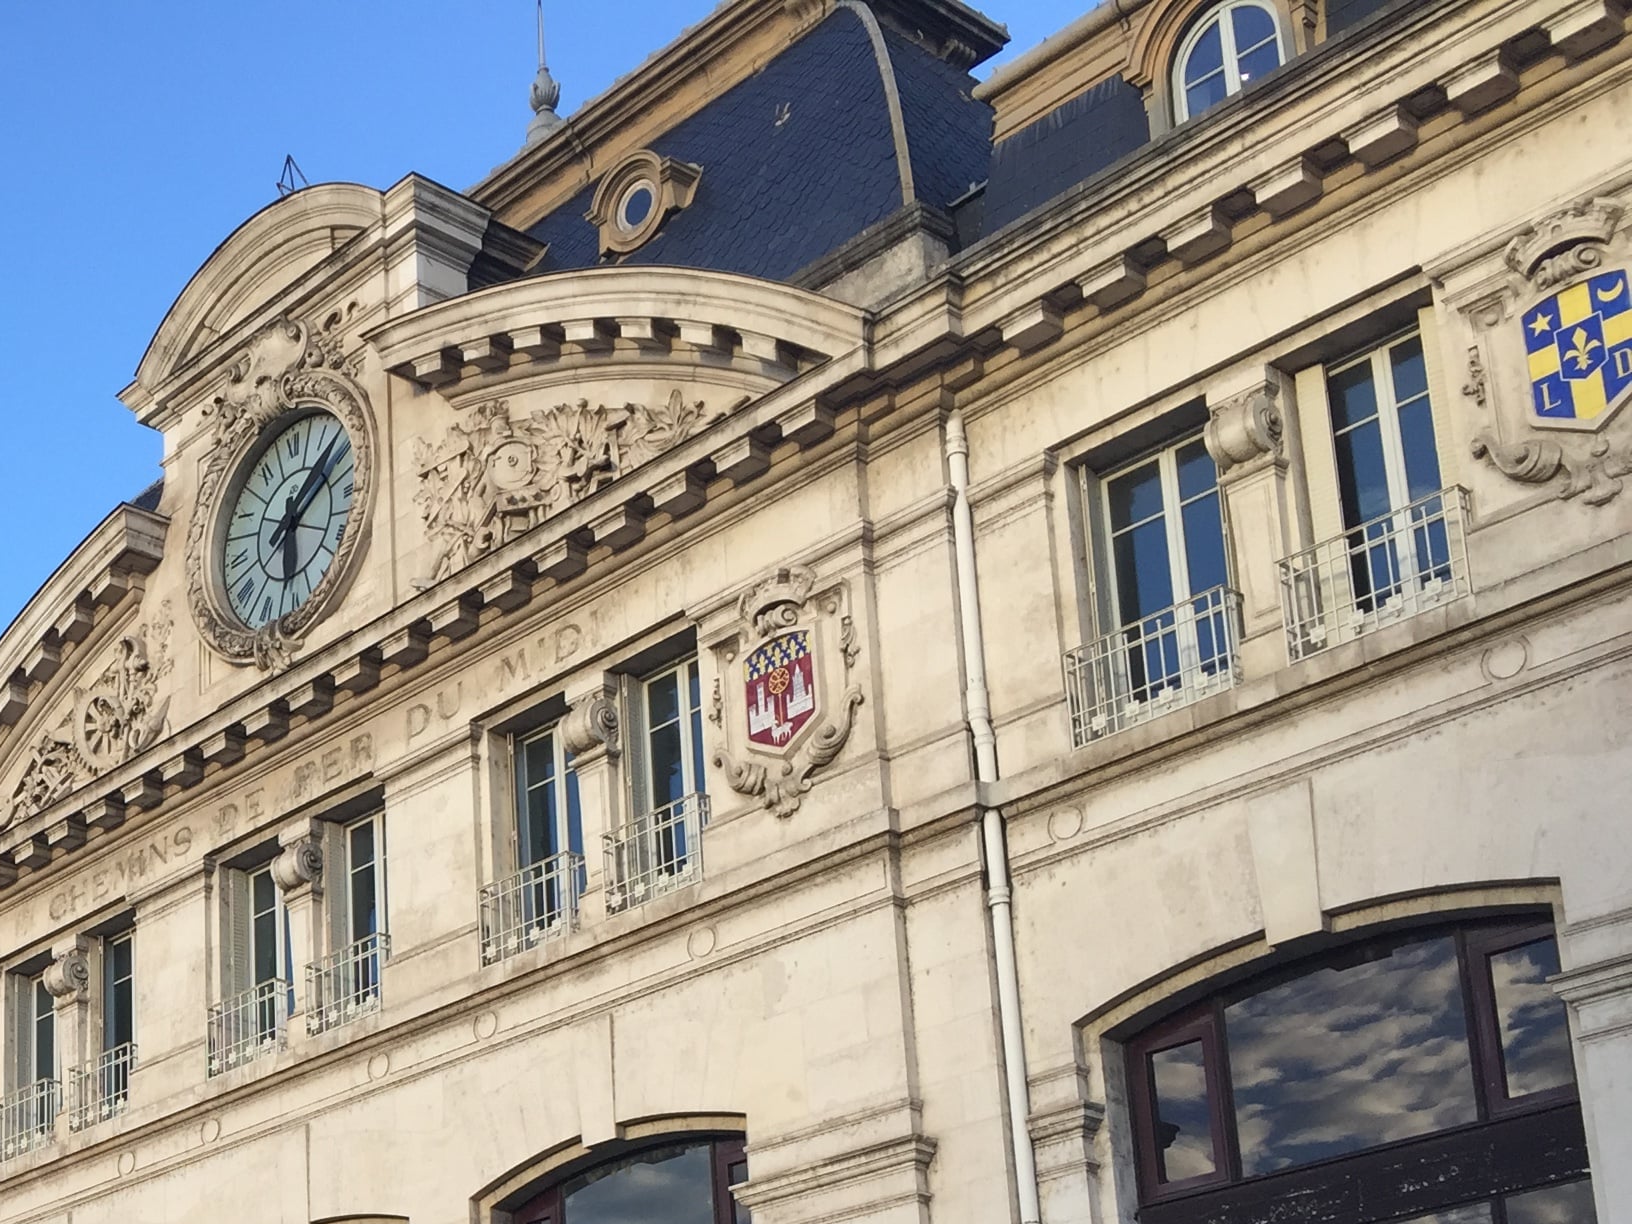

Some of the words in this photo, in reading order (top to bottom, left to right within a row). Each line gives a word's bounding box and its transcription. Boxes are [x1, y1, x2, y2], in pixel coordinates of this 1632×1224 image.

[1540, 383, 1562, 412] L
[286, 431, 300, 459] XII
[260, 462, 274, 487] XI
[237, 508, 255, 522] X
[230, 548, 249, 570] IX
[48, 826, 195, 921] CHEMINS
[218, 786, 267, 836] DE
[406, 681, 464, 744] DU
